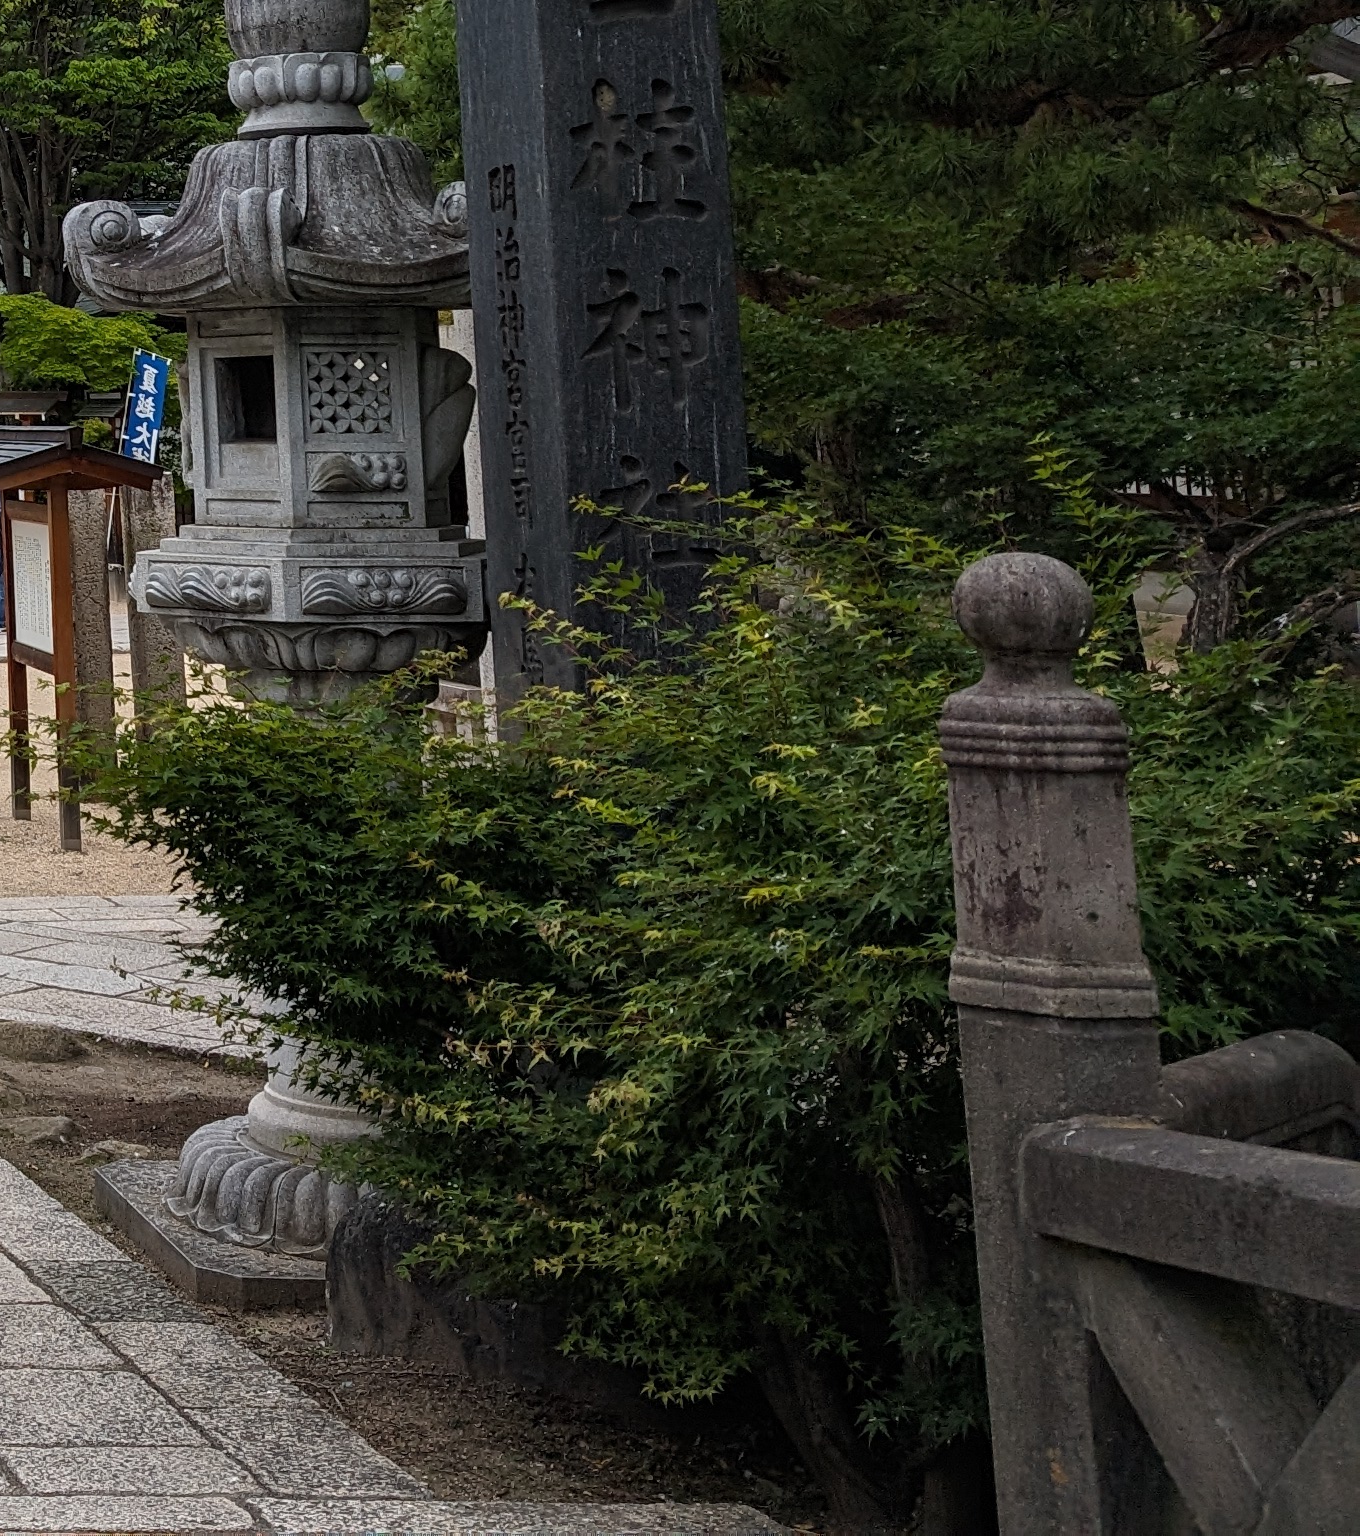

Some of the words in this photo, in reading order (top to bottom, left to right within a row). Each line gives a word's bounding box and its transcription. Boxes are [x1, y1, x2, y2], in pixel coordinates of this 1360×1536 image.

[487, 163, 534, 531] 明治神宮宮司
